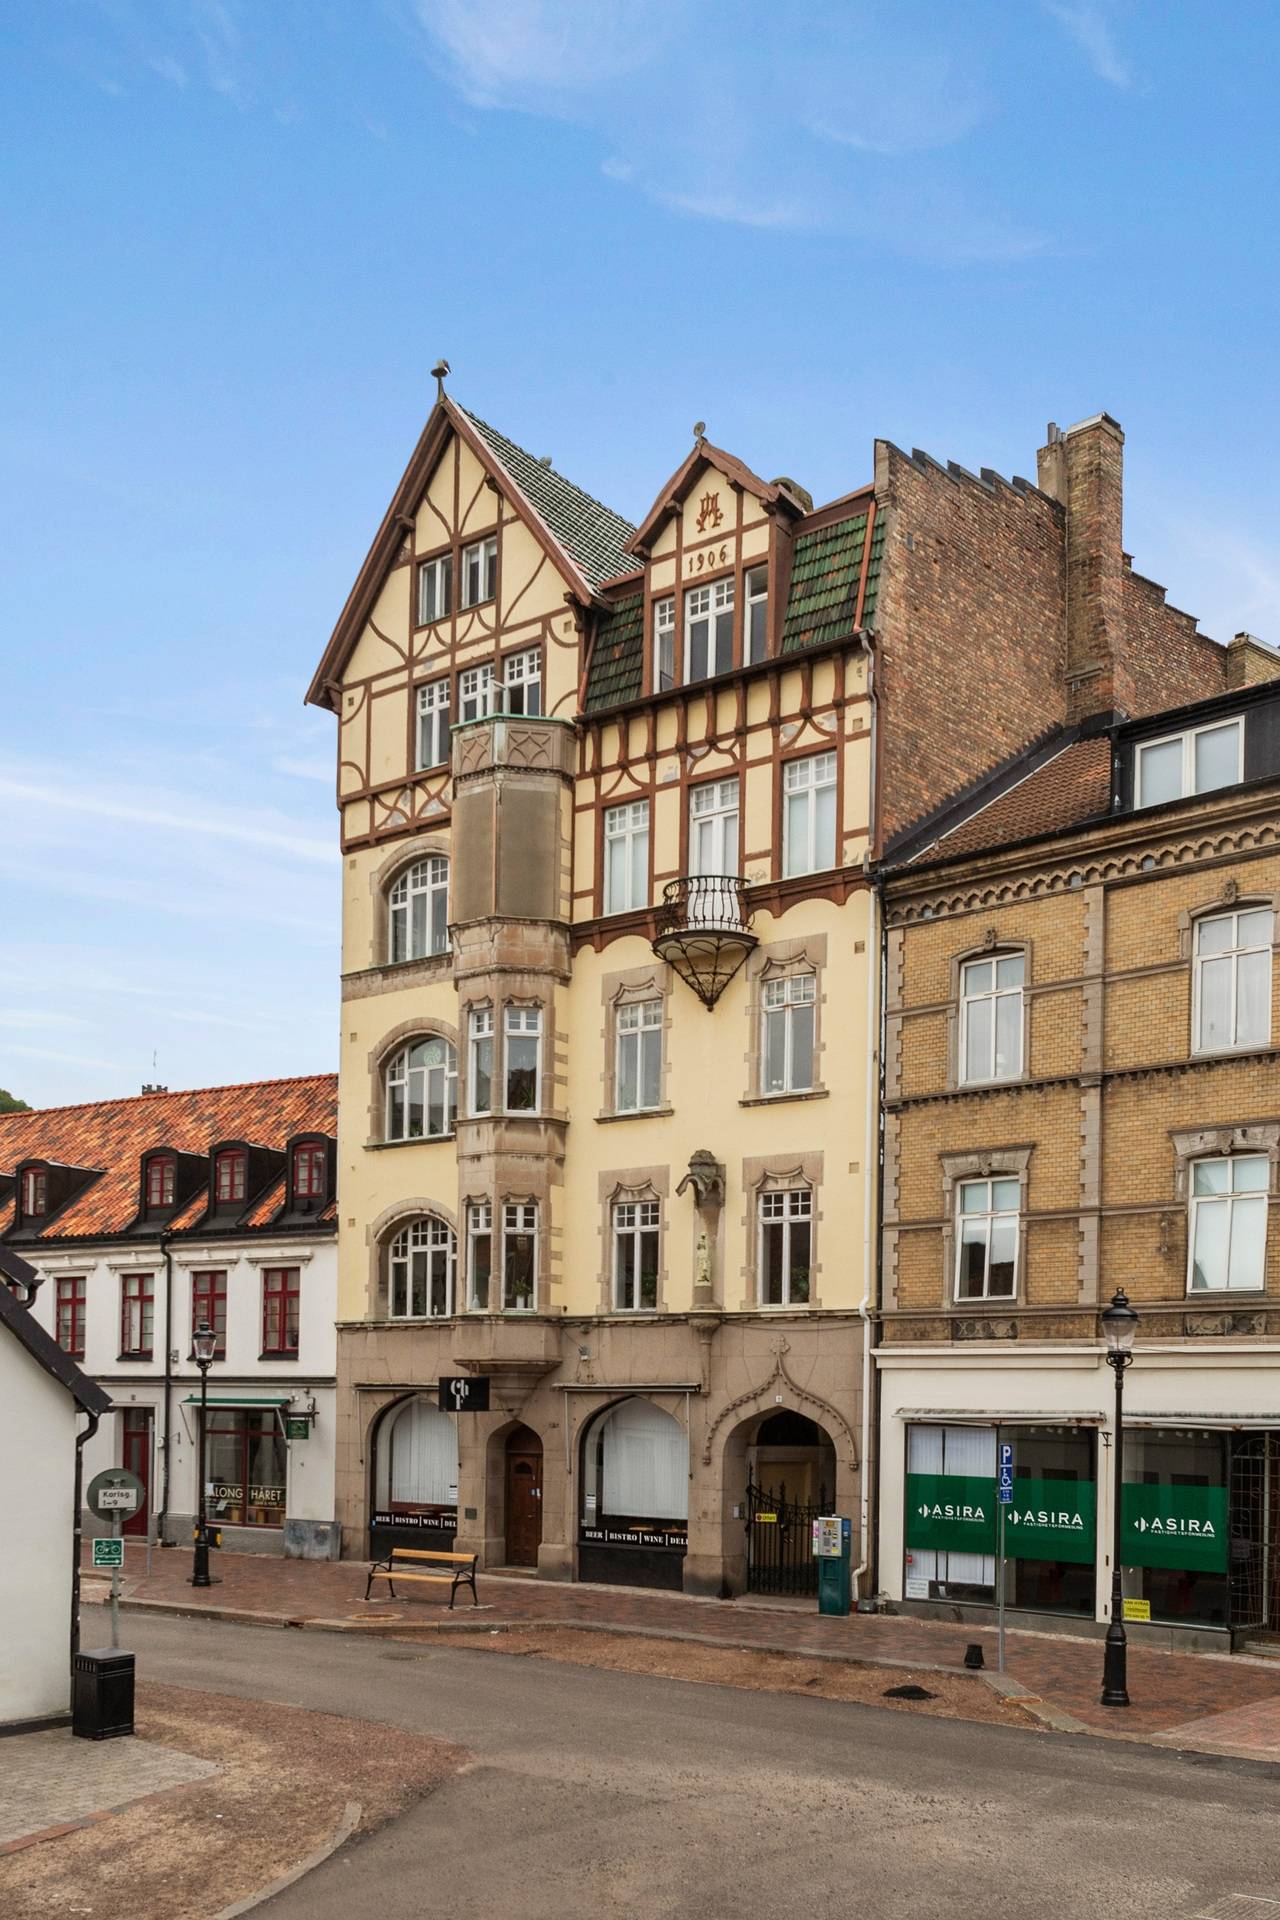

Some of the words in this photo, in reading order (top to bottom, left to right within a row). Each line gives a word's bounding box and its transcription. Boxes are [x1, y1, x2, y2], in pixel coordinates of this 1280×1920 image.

[688, 544, 727, 573] 1906
[1003, 1446, 1011, 1464] P
[250, 1487, 282, 1501] HÅRET
[932, 1504, 985, 1518] ASIRA
[395, 1516, 418, 1525] BISTRO
[422, 1518, 440, 1526] WINE
[1023, 1511, 1084, 1526] ASIRA
[1151, 1517, 1215, 1533] ASIRA
[585, 1530, 603, 1539] BEER
[609, 1532, 637, 1541] BISTRO
[643, 1535, 664, 1544] WINE
